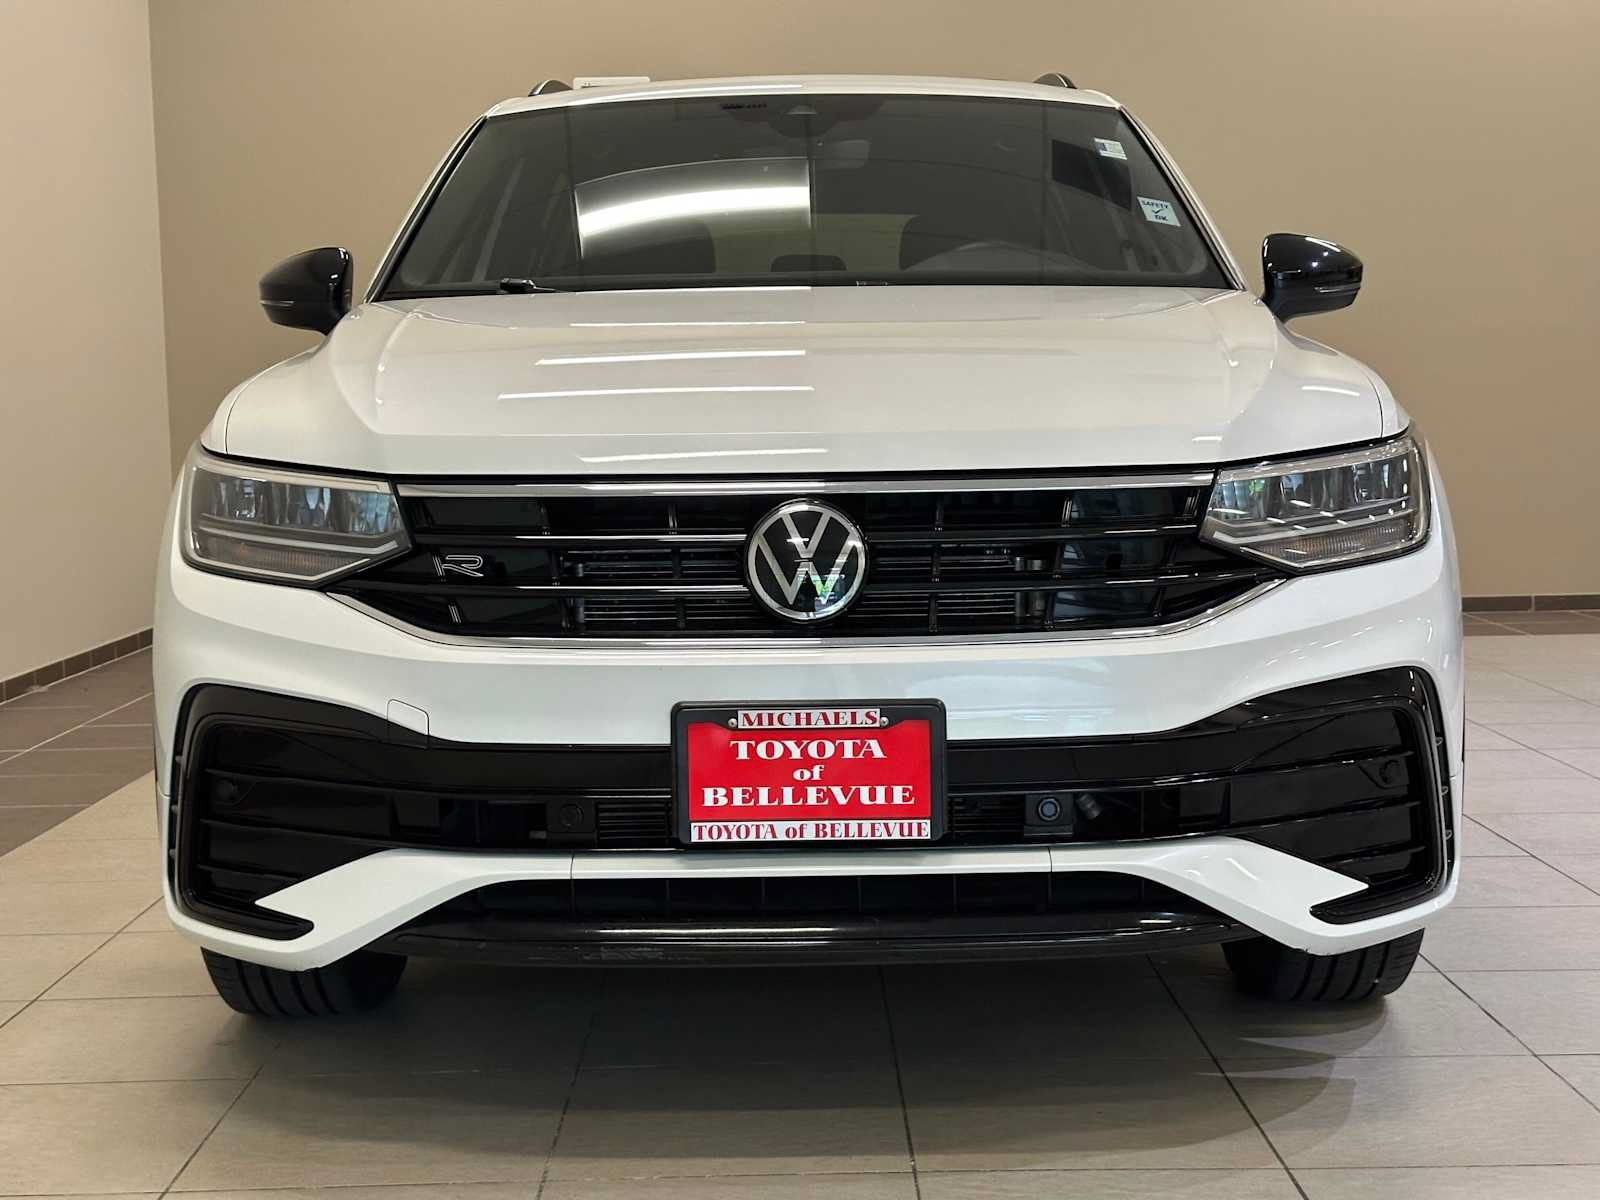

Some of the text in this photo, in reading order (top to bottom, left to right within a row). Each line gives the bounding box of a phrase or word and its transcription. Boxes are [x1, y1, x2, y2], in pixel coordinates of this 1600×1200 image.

[741, 710, 878, 727] MICHAELS
[730, 738, 887, 761] TOYOTA
[792, 764, 825, 781] of
[701, 784, 915, 807] BELLEVUE
[693, 820, 929, 841] TOYOTA of BELLEVUE
